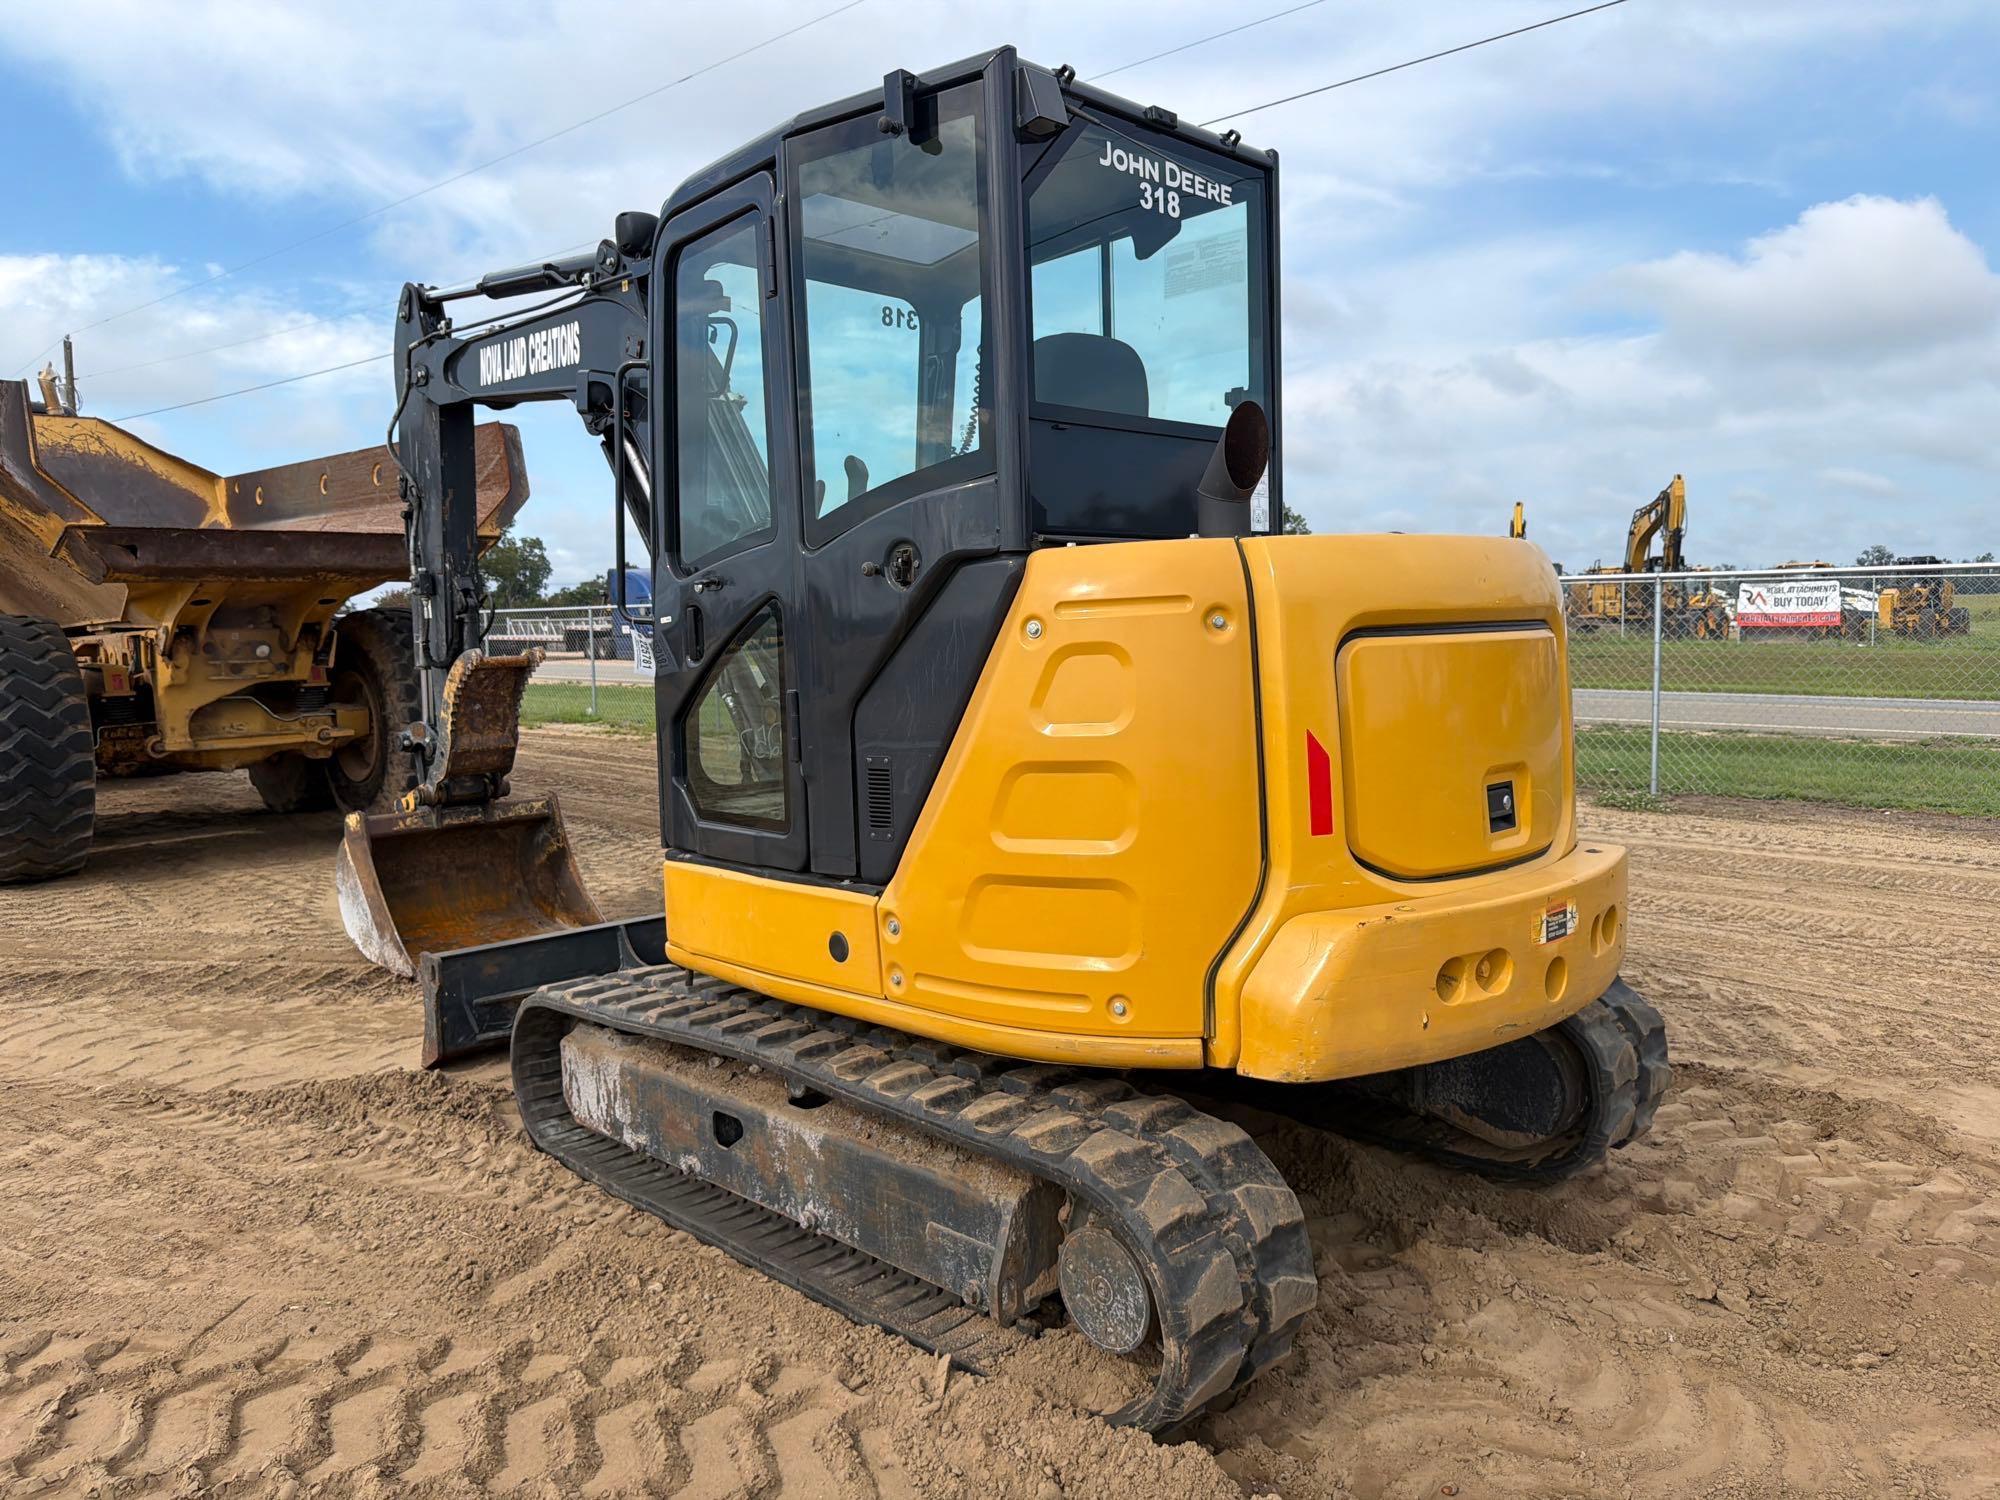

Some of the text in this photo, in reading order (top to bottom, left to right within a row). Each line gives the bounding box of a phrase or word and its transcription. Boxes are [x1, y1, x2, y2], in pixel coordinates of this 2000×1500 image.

[1100, 141, 1232, 206] JOHN DEERE
[1140, 182, 1180, 218] 318
[480, 321, 580, 386] NOVA LAND CREATIONS
[1766, 584, 1837, 594] REBEL ATTACHMENTS
[1774, 596, 1828, 607] BUY TODAY!
[640, 639, 653, 669] 225781
